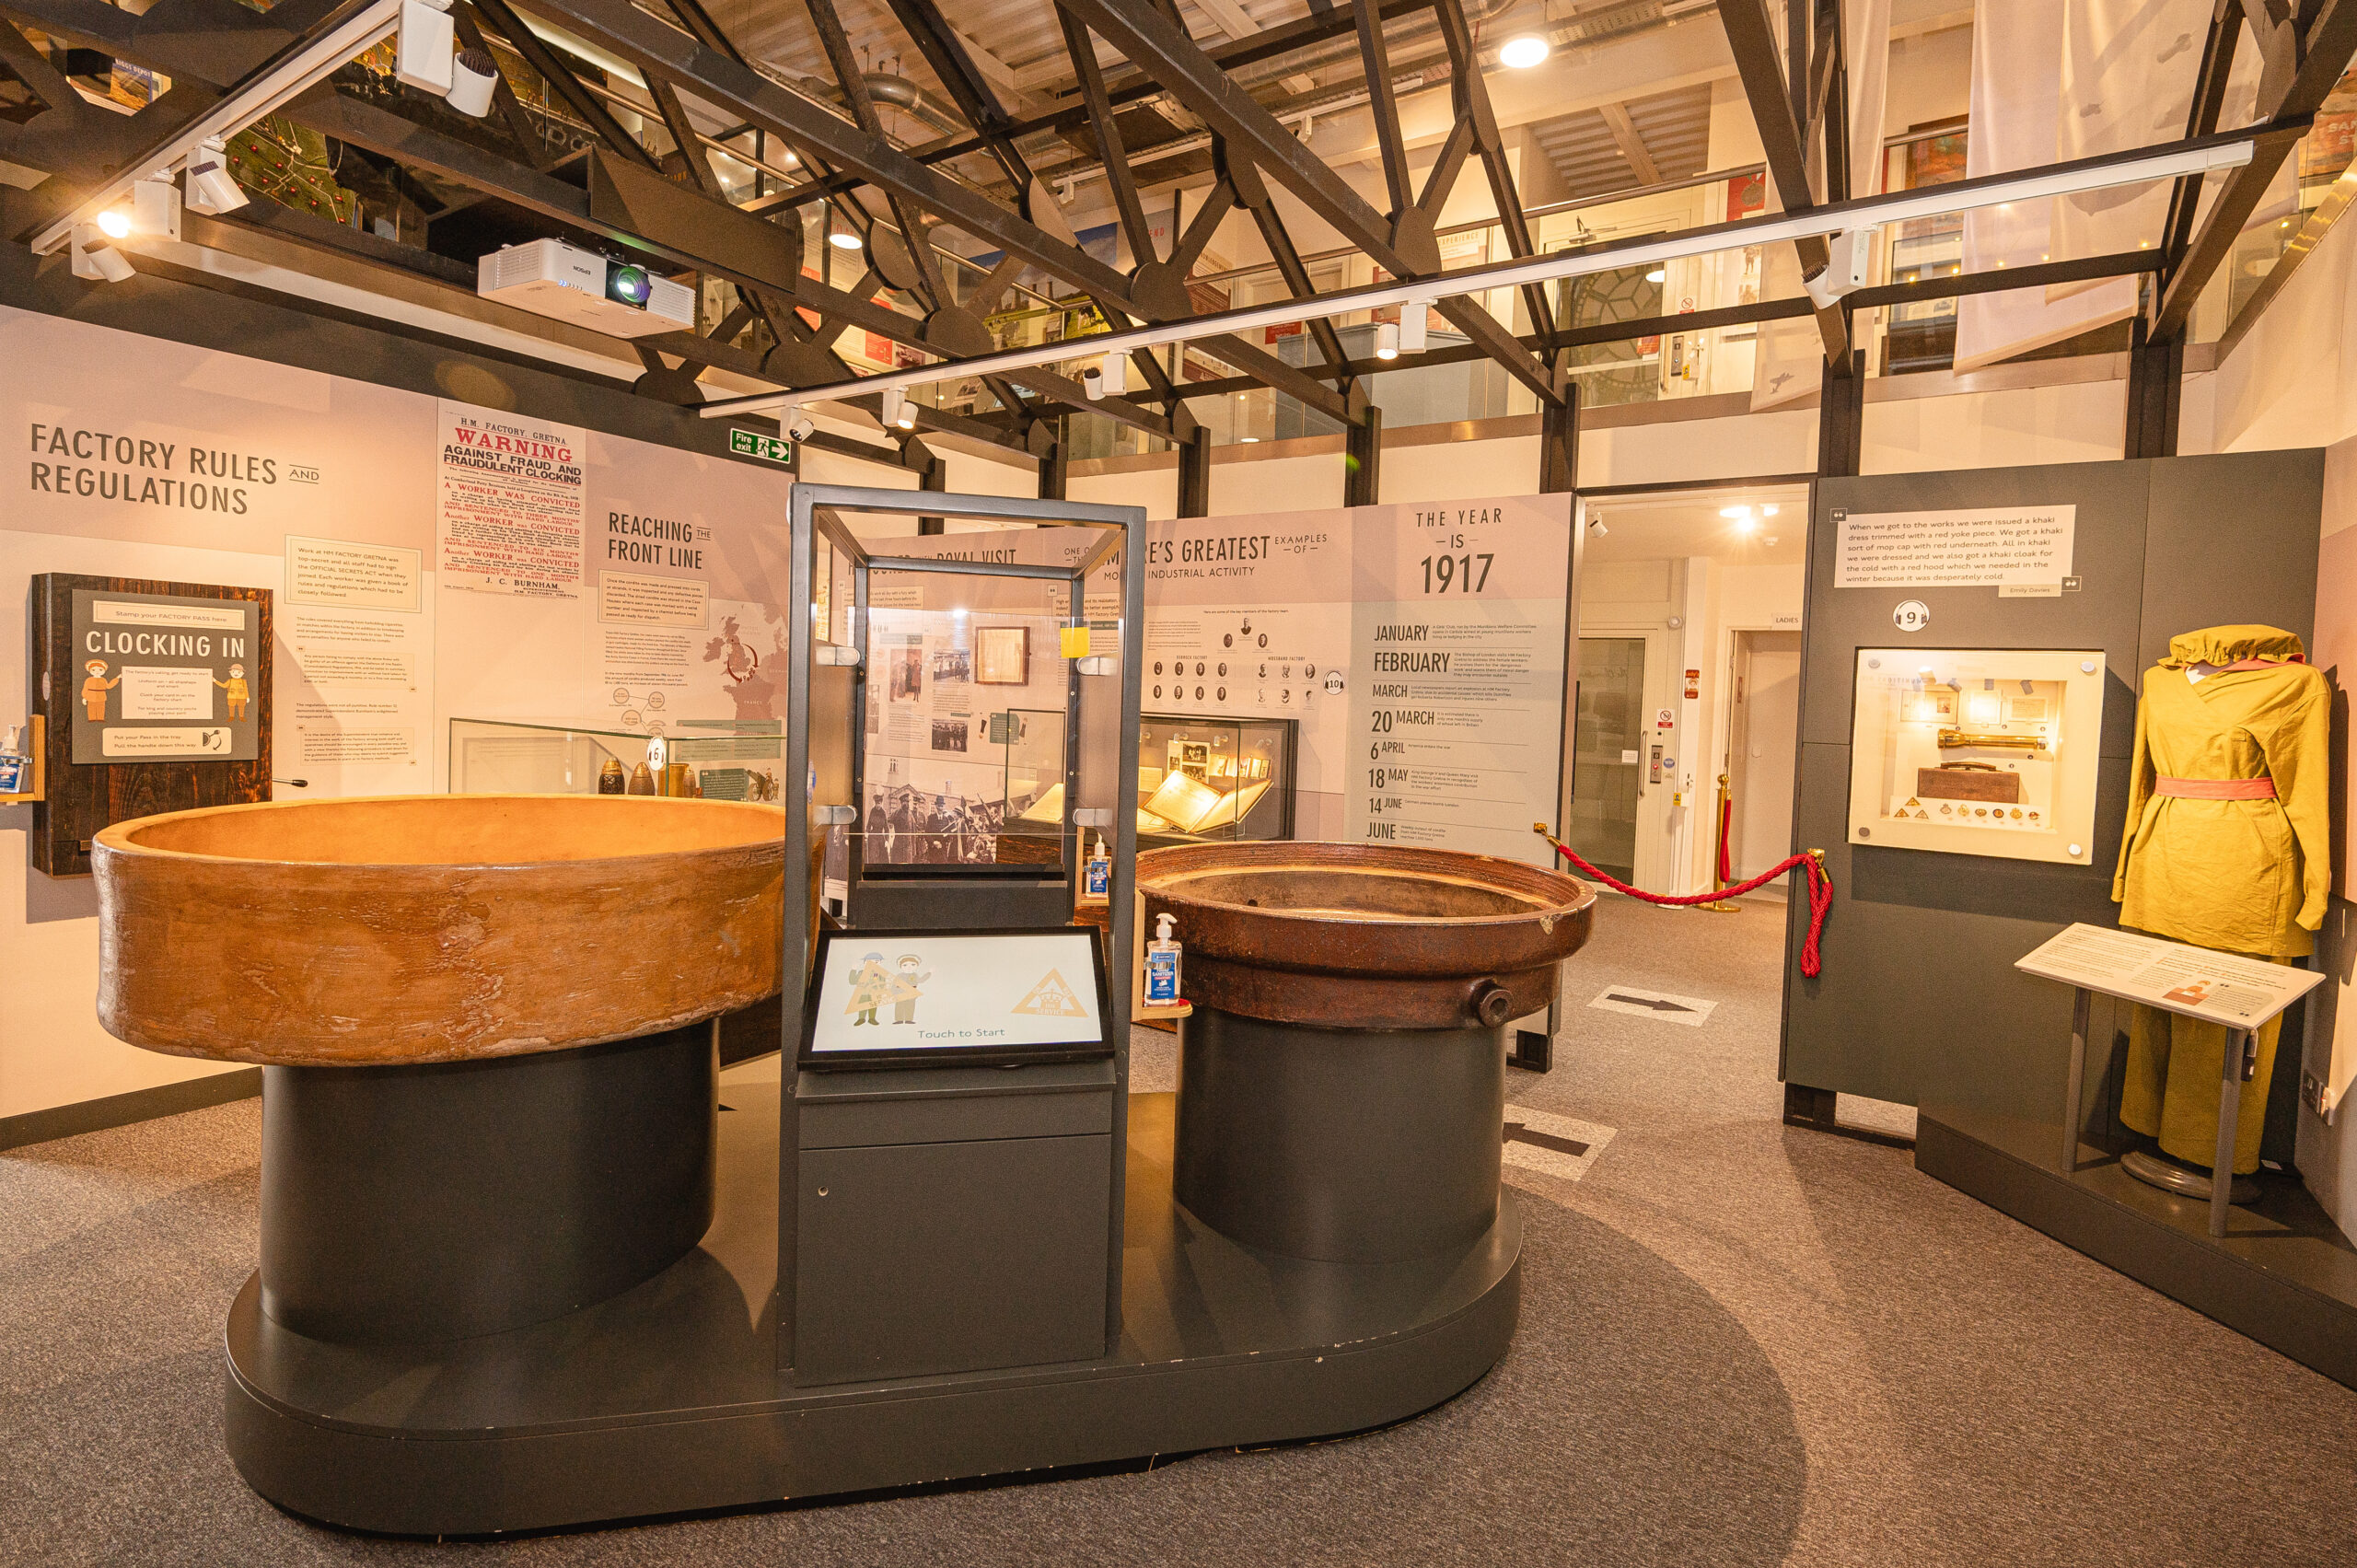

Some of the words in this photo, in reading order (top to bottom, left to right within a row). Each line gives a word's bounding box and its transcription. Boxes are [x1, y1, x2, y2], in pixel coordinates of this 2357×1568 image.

[573, 265, 590, 275] EPSON
[461, 417, 479, 428] H.M.
[533, 432, 566, 445] GRETNA
[736, 434, 752, 443] Fire
[32, 423, 175, 470] FACTORY
[190, 448, 277, 484] RULES
[290, 468, 319, 481] AND
[455, 428, 572, 462] WARNING
[736, 443, 752, 453] exit
[444, 454, 523, 475] FRAUDULENT
[526, 468, 581, 484] CLOCKING
[445, 444, 502, 461] AGAINST
[510, 456, 551, 470] FRAUD
[558, 465, 581, 475] AND
[31, 462, 248, 515] REGULATIONS
[458, 484, 498, 496] WORKER
[505, 491, 525, 500] WAS
[531, 495, 580, 508] CONVICTED
[444, 511, 469, 520] Another
[474, 515, 513, 526] WORKER
[531, 523, 579, 535] CONVICTED
[1416, 512, 1445, 527] THE
[1458, 508, 1501, 525] YEAR
[609, 512, 692, 543] REACHING
[697, 529, 711, 538] THE
[1182, 536, 1270, 562] GREATEST
[1275, 534, 1327, 544] EXAMPLES
[1451, 534, 1464, 548] IS
[444, 548, 469, 556] Another
[474, 550, 512, 561] WORKER
[530, 557, 579, 568] CONVICTED
[608, 539, 662, 564] FRONT
[670, 547, 702, 569] LINE
[1148, 569, 1204, 579] INDUSTRIAL
[1209, 567, 1255, 577] ACTIVITY
[1421, 554, 1495, 593] 1917
[515, 580, 560, 590] BURNHAM.
[1907, 612, 1916, 624] 9
[1375, 625, 1429, 641] JANUARY
[86, 631, 210, 657] CLOCKING
[222, 638, 245, 658] IN
[1375, 653, 1450, 672] FEBRUARY
[1372, 685, 1407, 698] MARCH
[1372, 711, 1392, 733] 20
[1396, 711, 1434, 725] MARCH
[654, 748, 659, 760] 6
[1371, 742, 1378, 759] 6
[1382, 742, 1405, 754] APRIL
[1368, 768, 1385, 788] 18
[1388, 768, 1408, 782] MAY
[1369, 798, 1382, 814] 14
[1384, 799, 1402, 809] JUNE
[1367, 822, 1396, 840] JUNE
[918, 1030, 955, 1038] Touch
[976, 1028, 1005, 1037] Start
